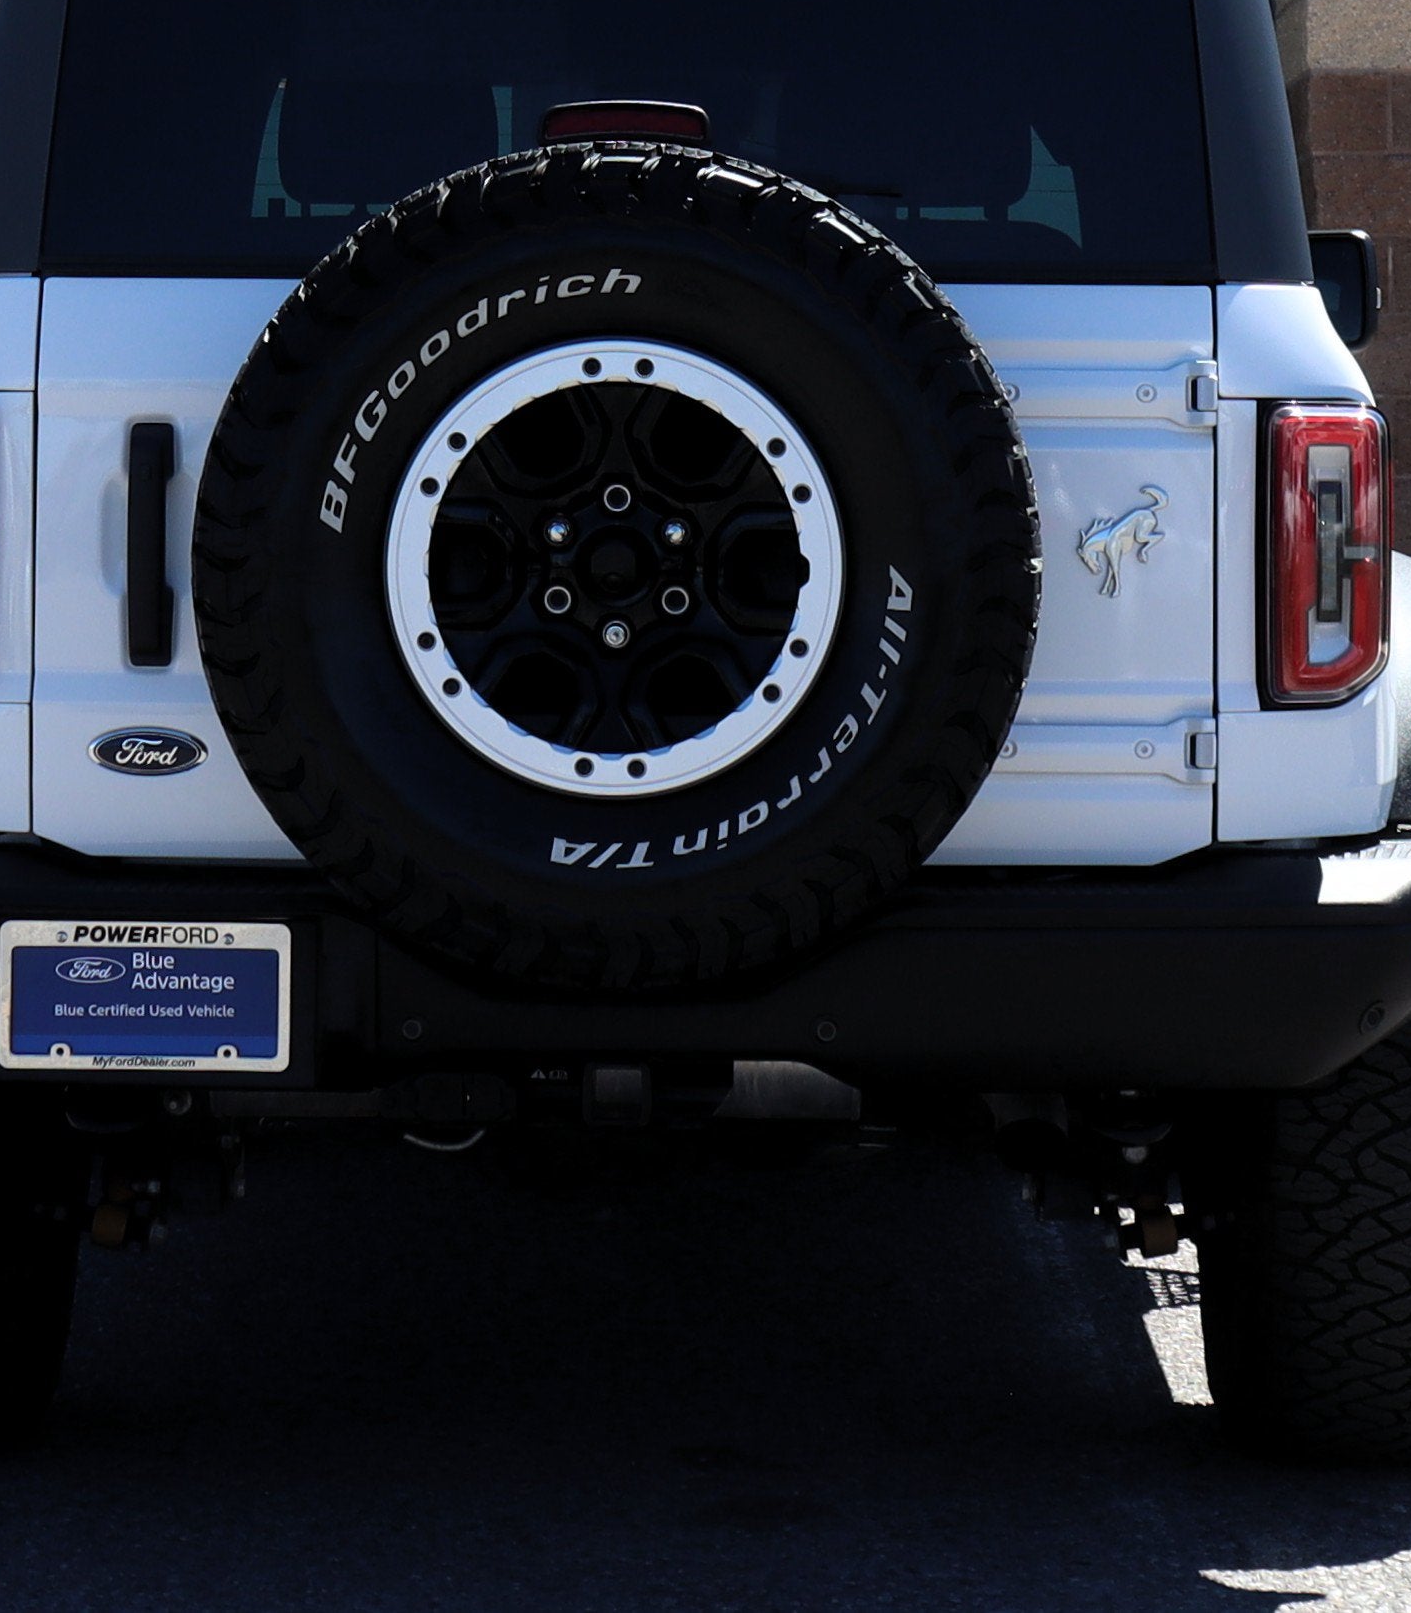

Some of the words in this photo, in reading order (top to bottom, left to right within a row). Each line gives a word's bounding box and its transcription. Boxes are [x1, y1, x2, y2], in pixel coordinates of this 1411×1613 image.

[320, 268, 642, 534] BFGoodrich
[673, 564, 915, 857] All-Terrain
[115, 737, 178, 766] Ford
[549, 836, 656, 869] T/A
[73, 925, 219, 944] POWERFORD
[68, 960, 112, 980] Ford
[132, 952, 175, 970] Blue
[131, 972, 235, 993] Advantage
[54, 1003, 85, 1017] Blue
[88, 1003, 145, 1018] Certified
[149, 1004, 184, 1018] Used
[187, 1004, 235, 1018] Vehicle
[92, 1056, 196, 1069] MyFordDealer.com
